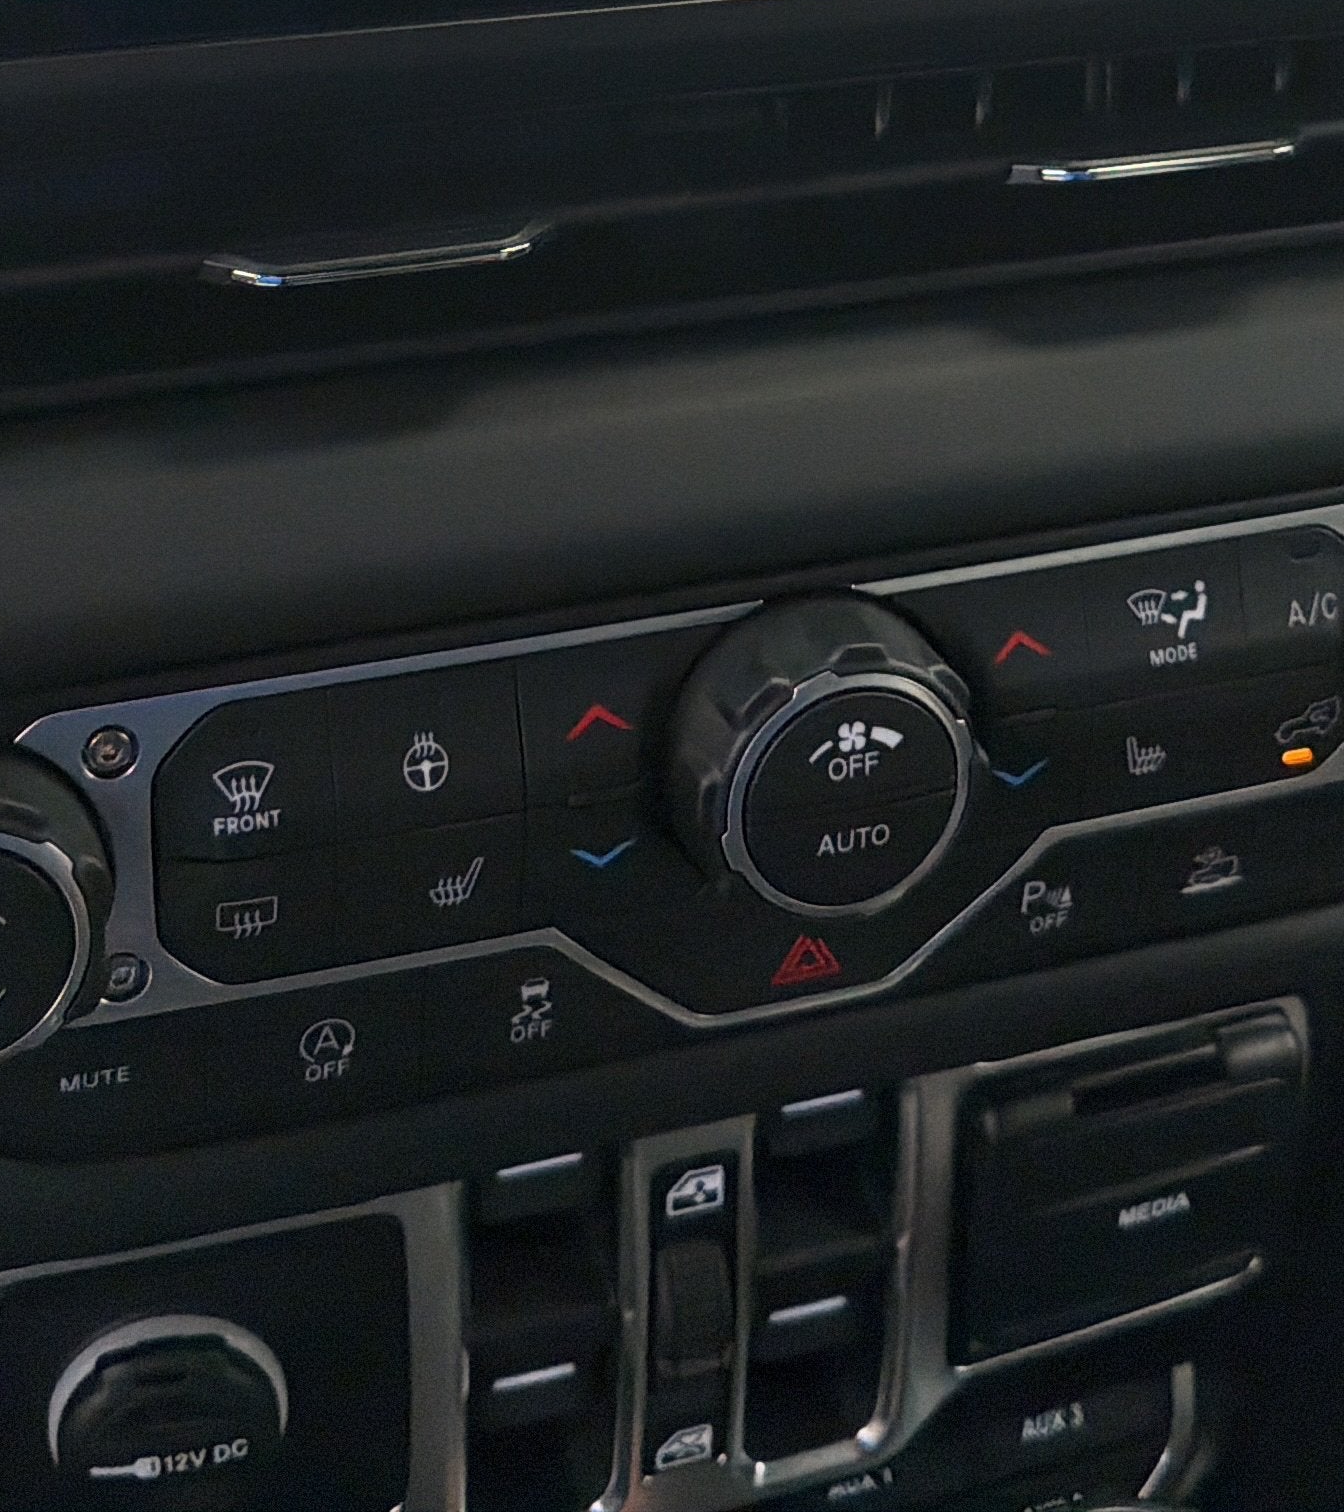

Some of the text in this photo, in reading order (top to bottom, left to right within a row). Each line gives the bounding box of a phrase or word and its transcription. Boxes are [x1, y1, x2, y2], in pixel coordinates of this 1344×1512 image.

[1288, 592, 1338, 628] A/C
[1147, 641, 1199, 666] MODE
[827, 750, 880, 780] OFF
[212, 808, 282, 835] FRONT
[816, 822, 891, 858] AUTO
[1030, 909, 1071, 932] OFF
[510, 1018, 554, 1042] OFF
[60, 1065, 131, 1092] MUTE
[304, 1058, 351, 1082] OFF
[1117, 1190, 1192, 1227] MEDIA
[163, 1438, 248, 1473] 12V DC
